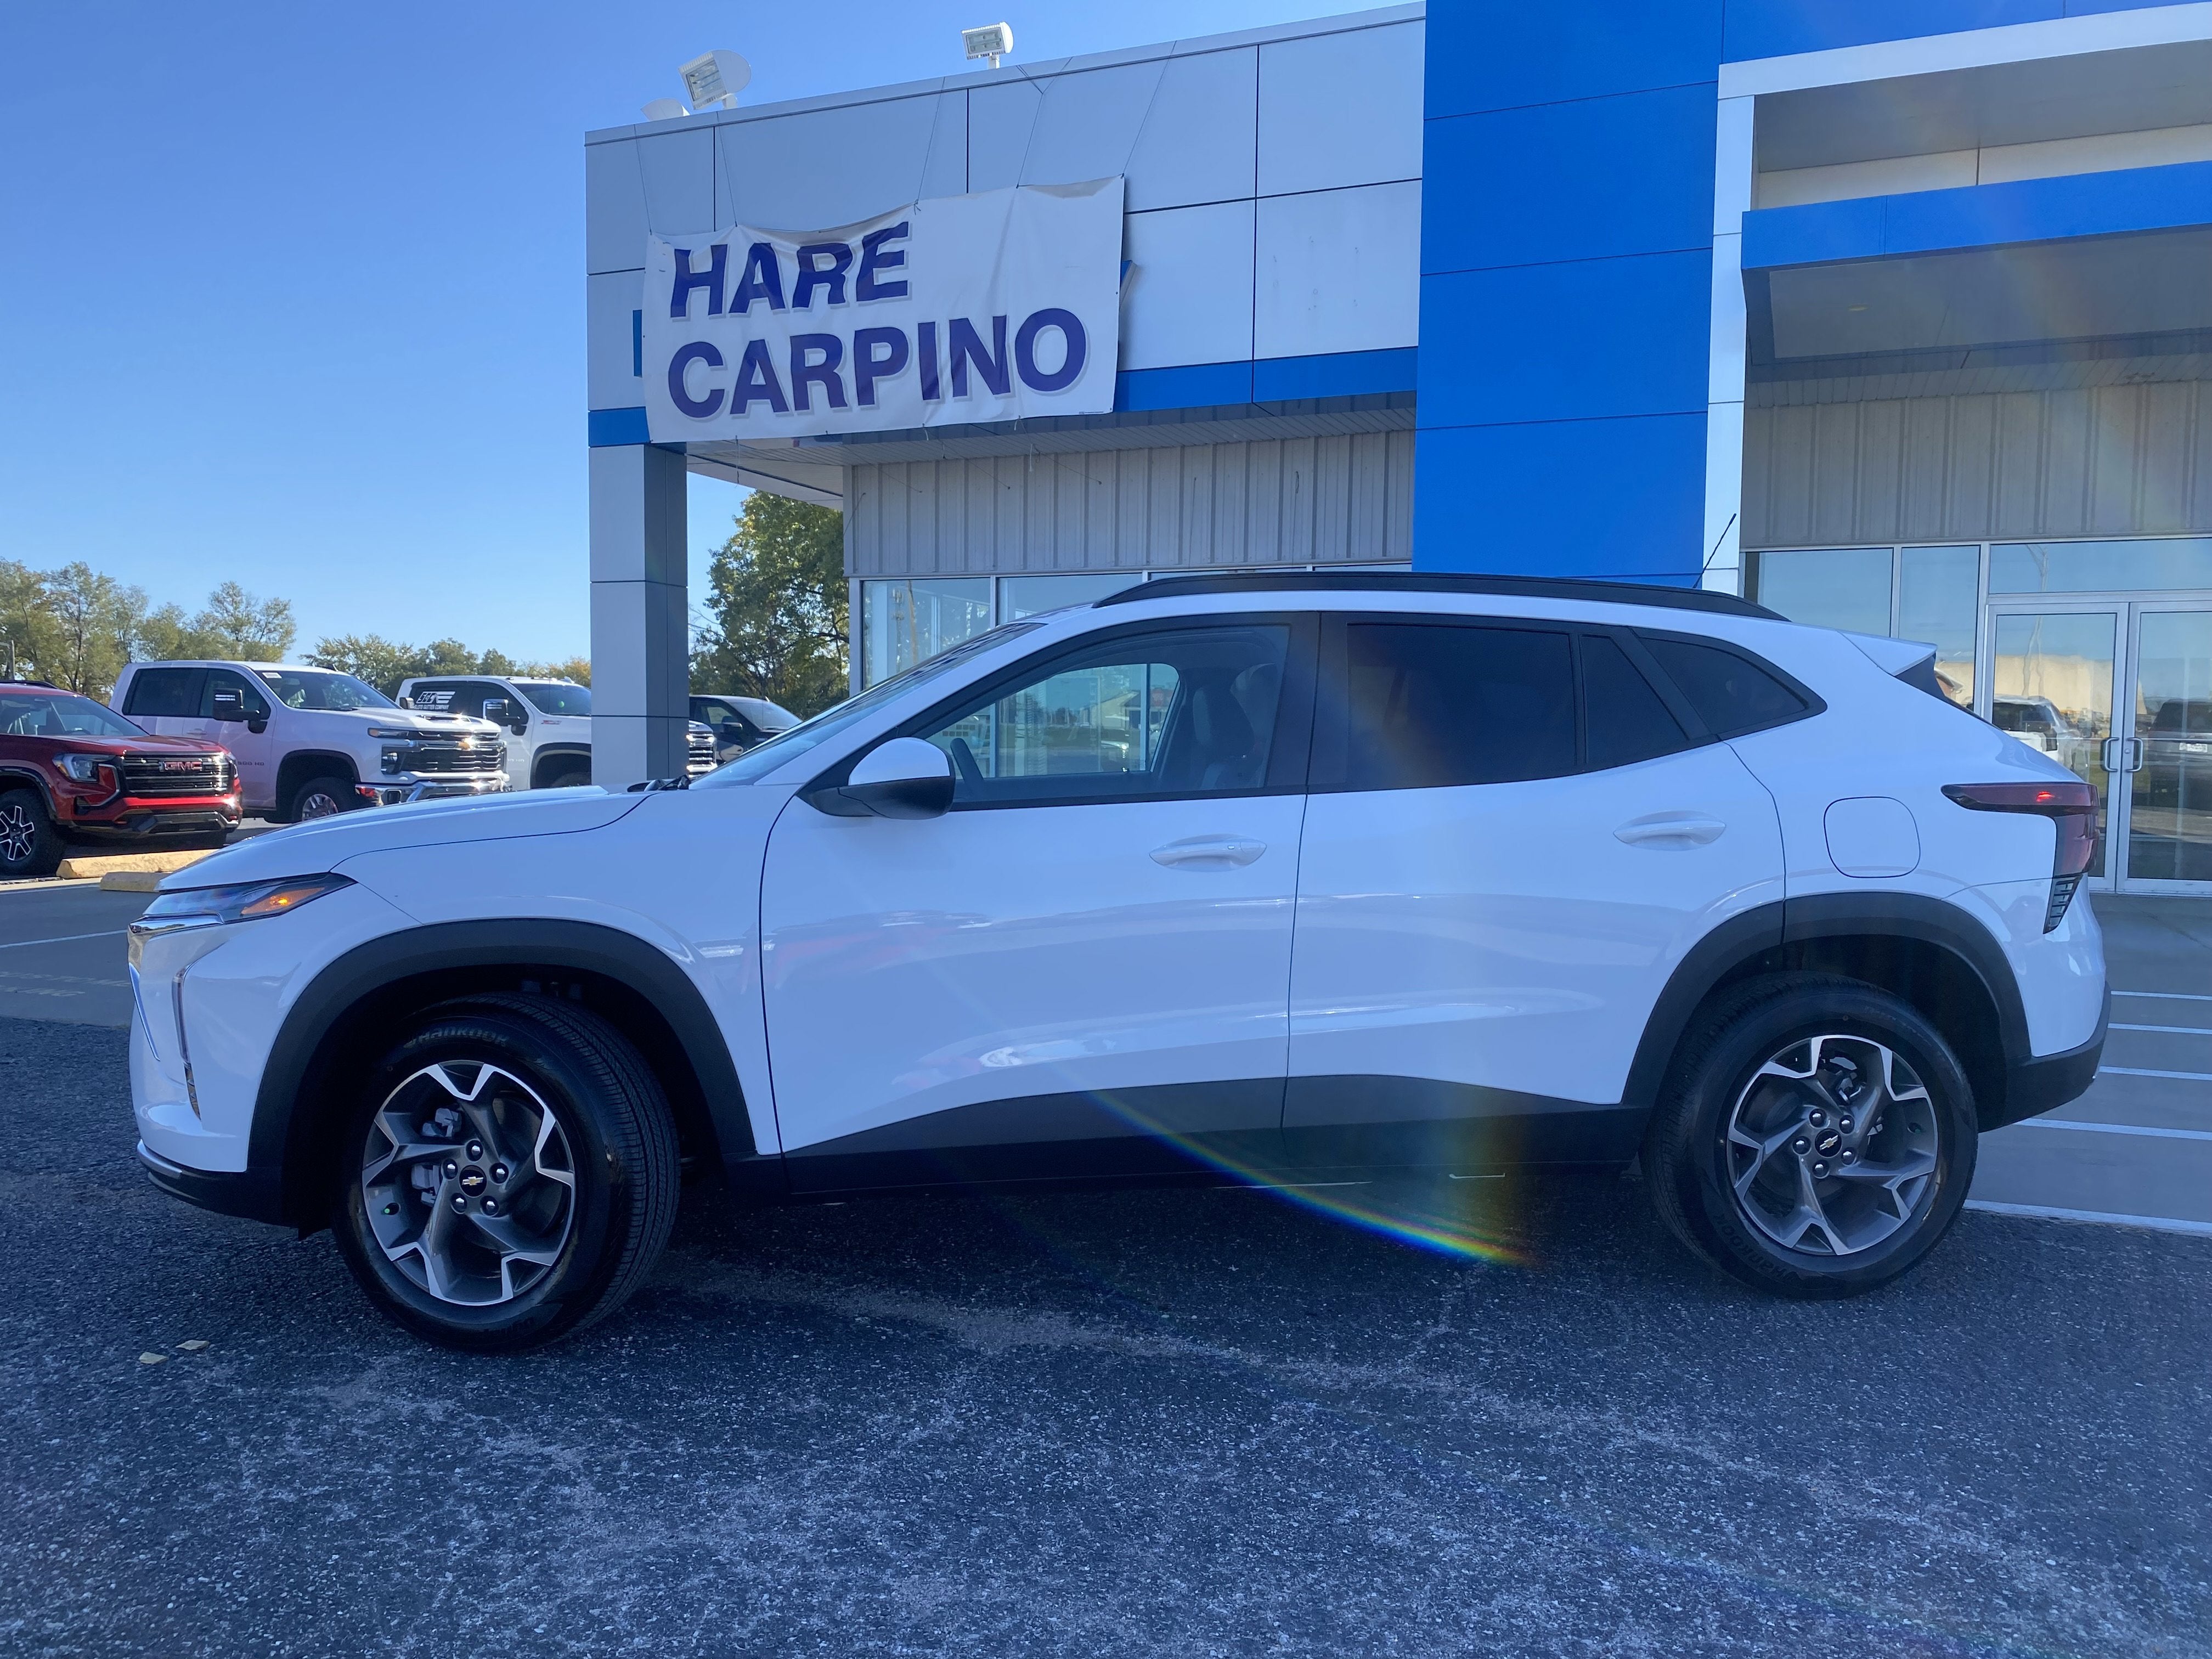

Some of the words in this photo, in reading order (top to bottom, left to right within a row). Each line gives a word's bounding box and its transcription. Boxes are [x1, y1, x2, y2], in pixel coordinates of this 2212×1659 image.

[670, 221, 909, 318] HARE
[668, 308, 1086, 417] CARPINO
[164, 761, 202, 772] GMC
